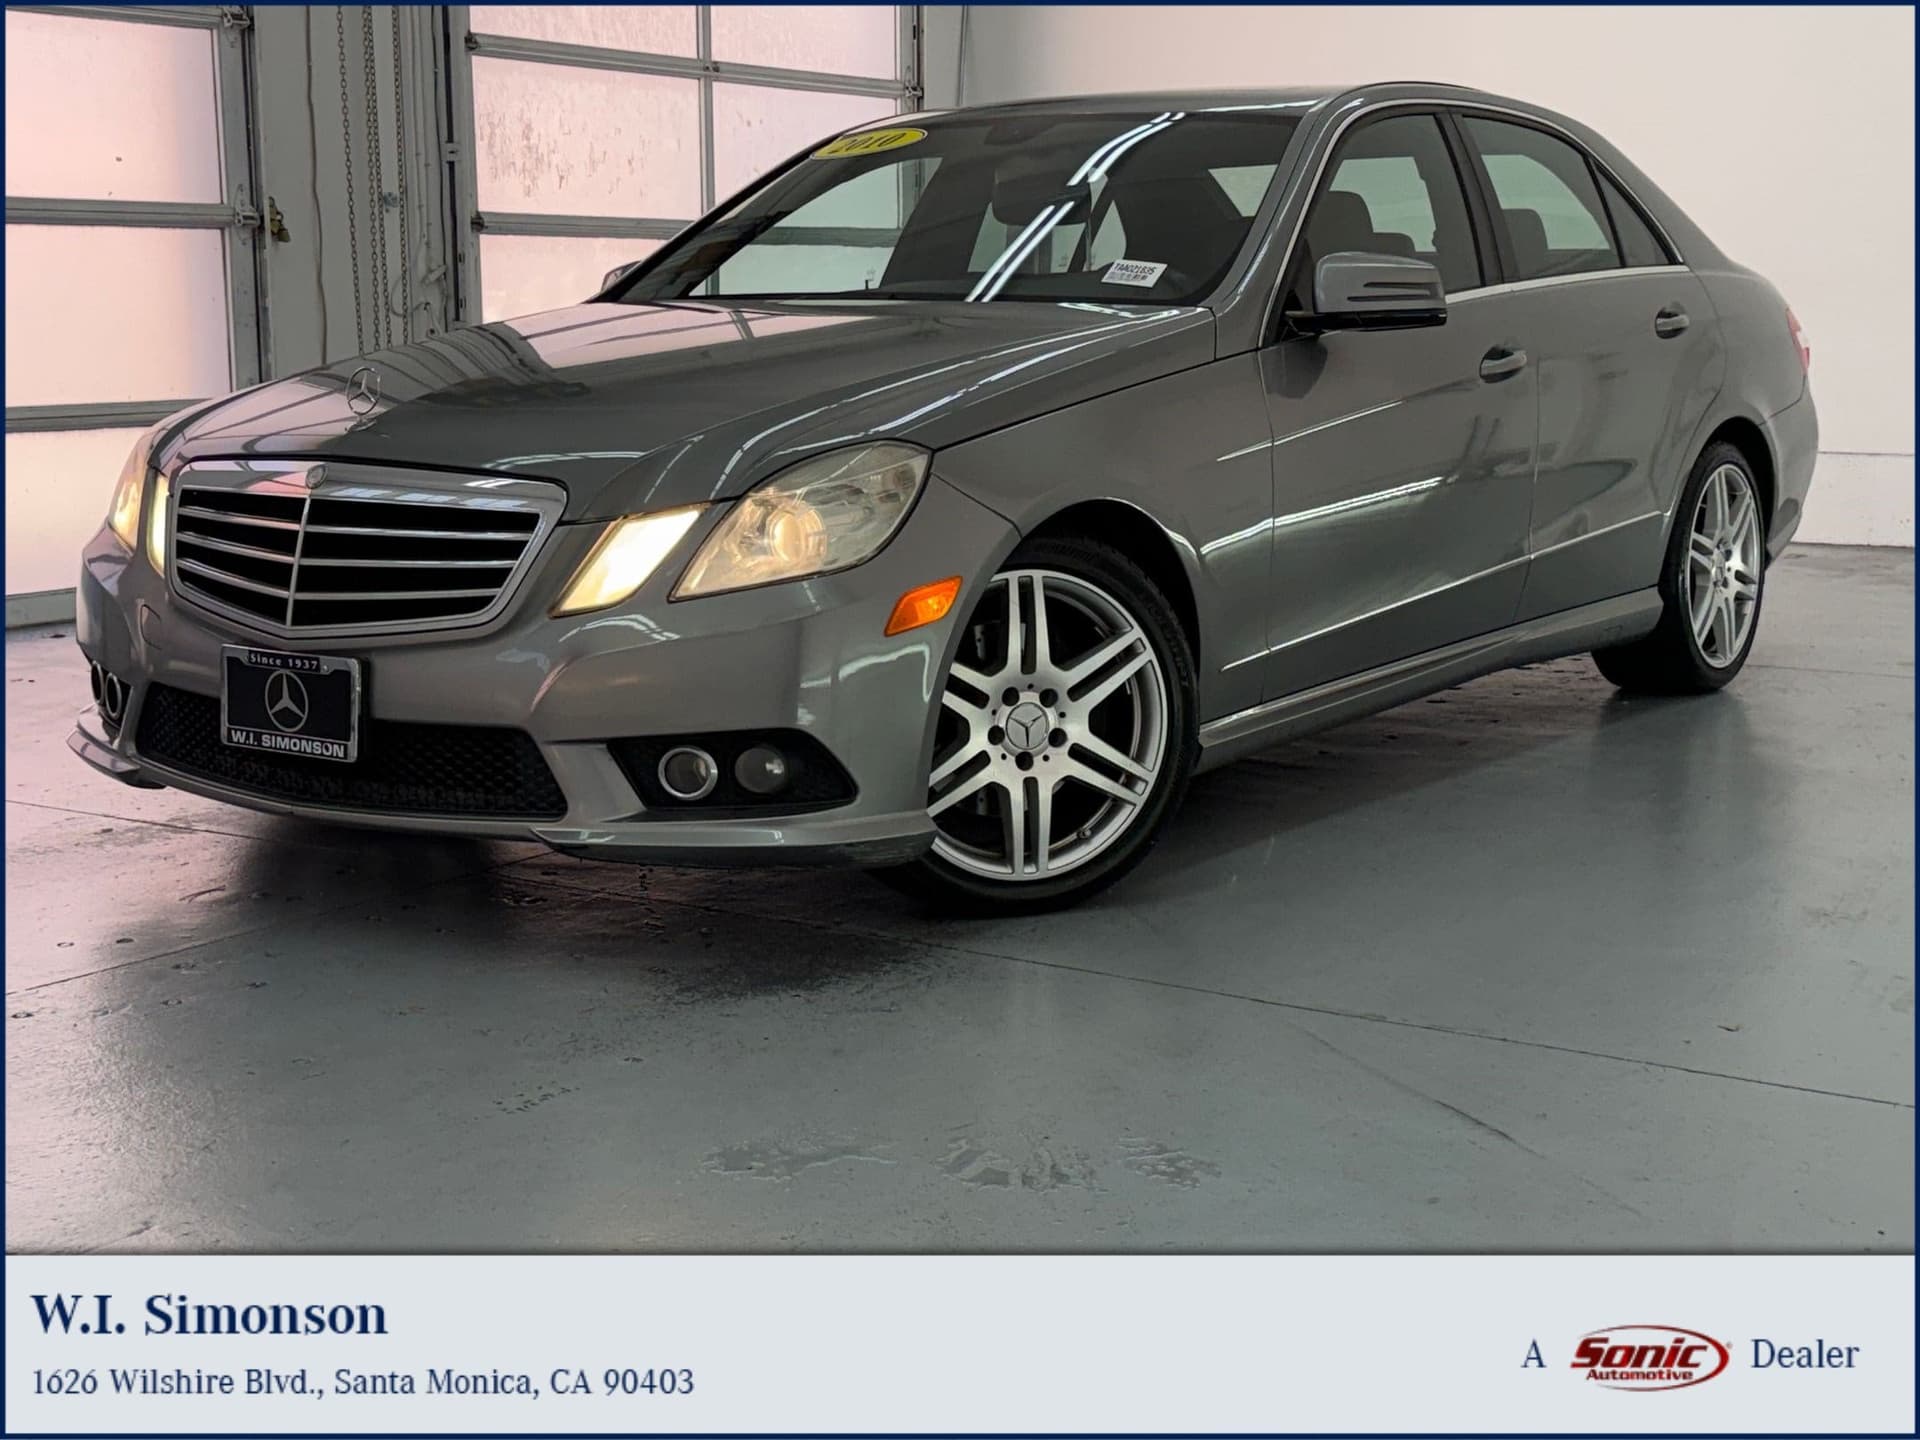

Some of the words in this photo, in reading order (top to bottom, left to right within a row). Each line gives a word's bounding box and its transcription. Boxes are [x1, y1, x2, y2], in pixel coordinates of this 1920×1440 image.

[827, 132, 908, 154] 2010
[249, 653, 283, 667] Since
[288, 658, 319, 670] 1937
[230, 729, 258, 745] W.I.
[261, 734, 345, 758] SIMONSON
